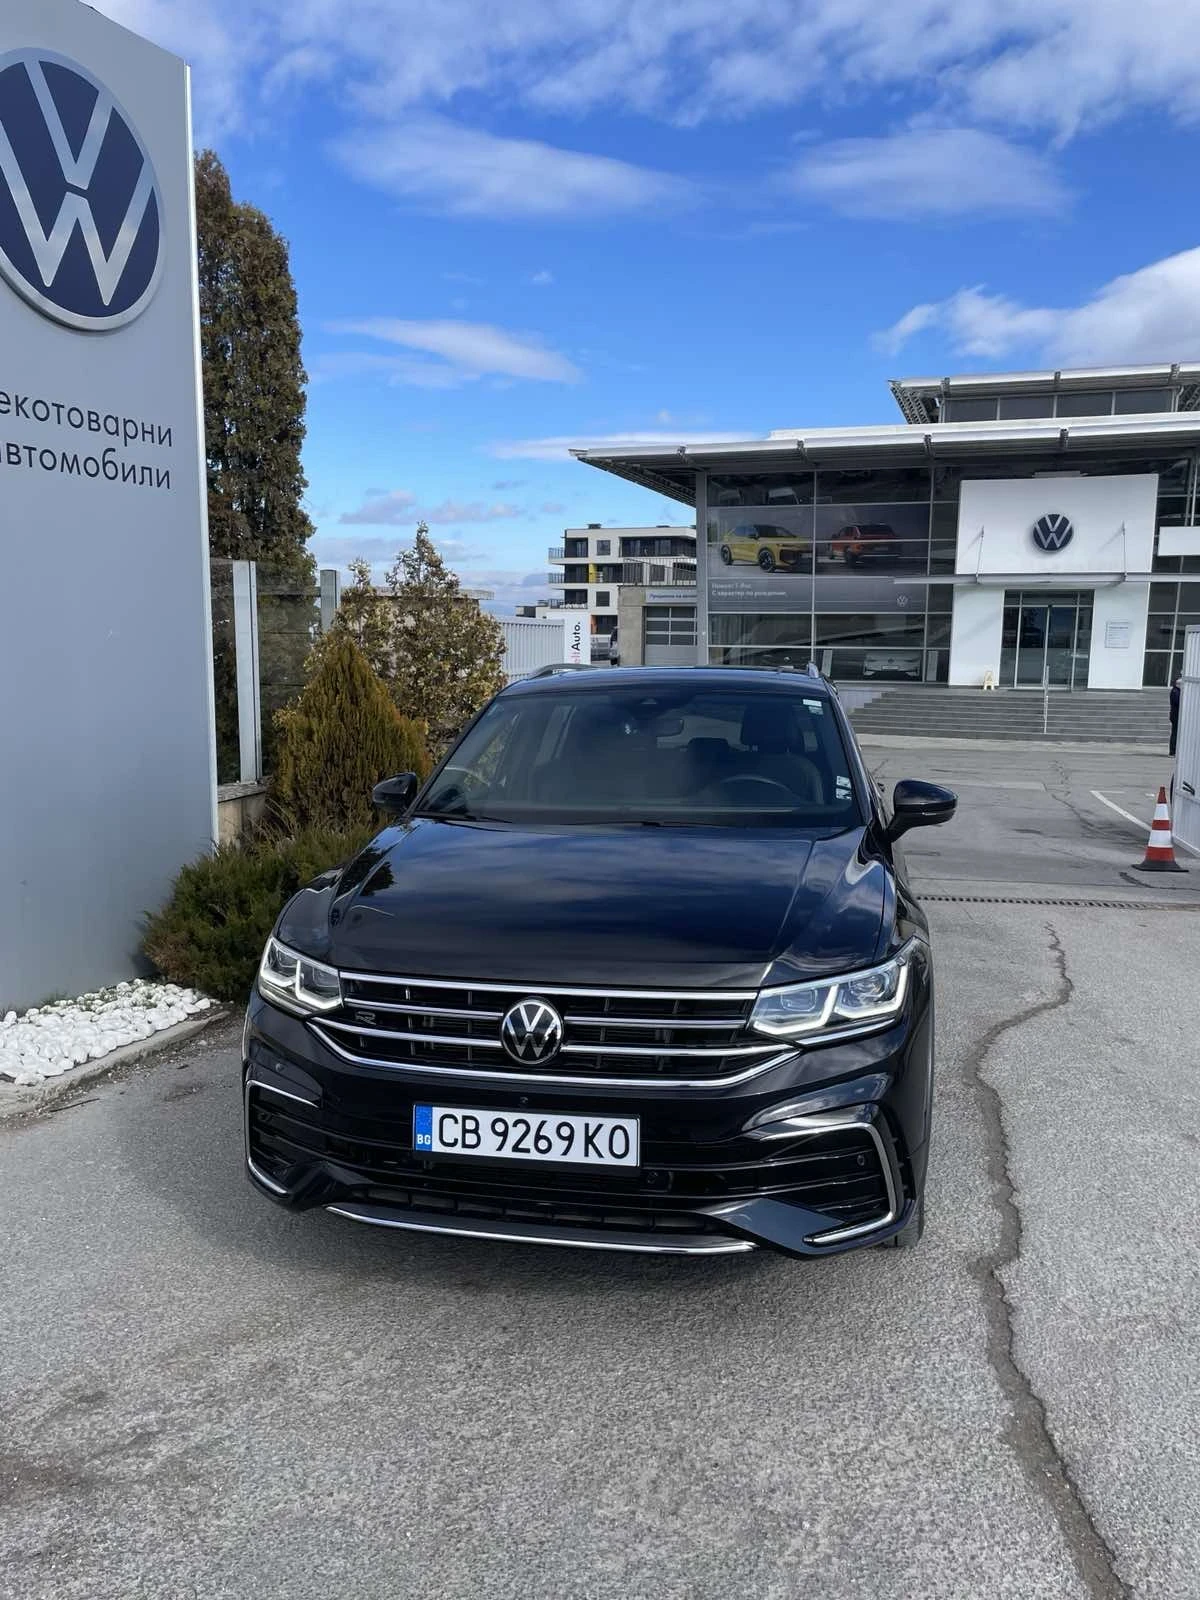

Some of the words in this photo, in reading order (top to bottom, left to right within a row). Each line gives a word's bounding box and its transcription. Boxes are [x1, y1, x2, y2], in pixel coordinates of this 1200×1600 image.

[0, 391, 173, 448] екотоварни
[0, 442, 171, 490] втомобили
[417, 1134, 431, 1145] BG
[438, 1113, 481, 1149] CB
[490, 1117, 575, 1156] 9269
